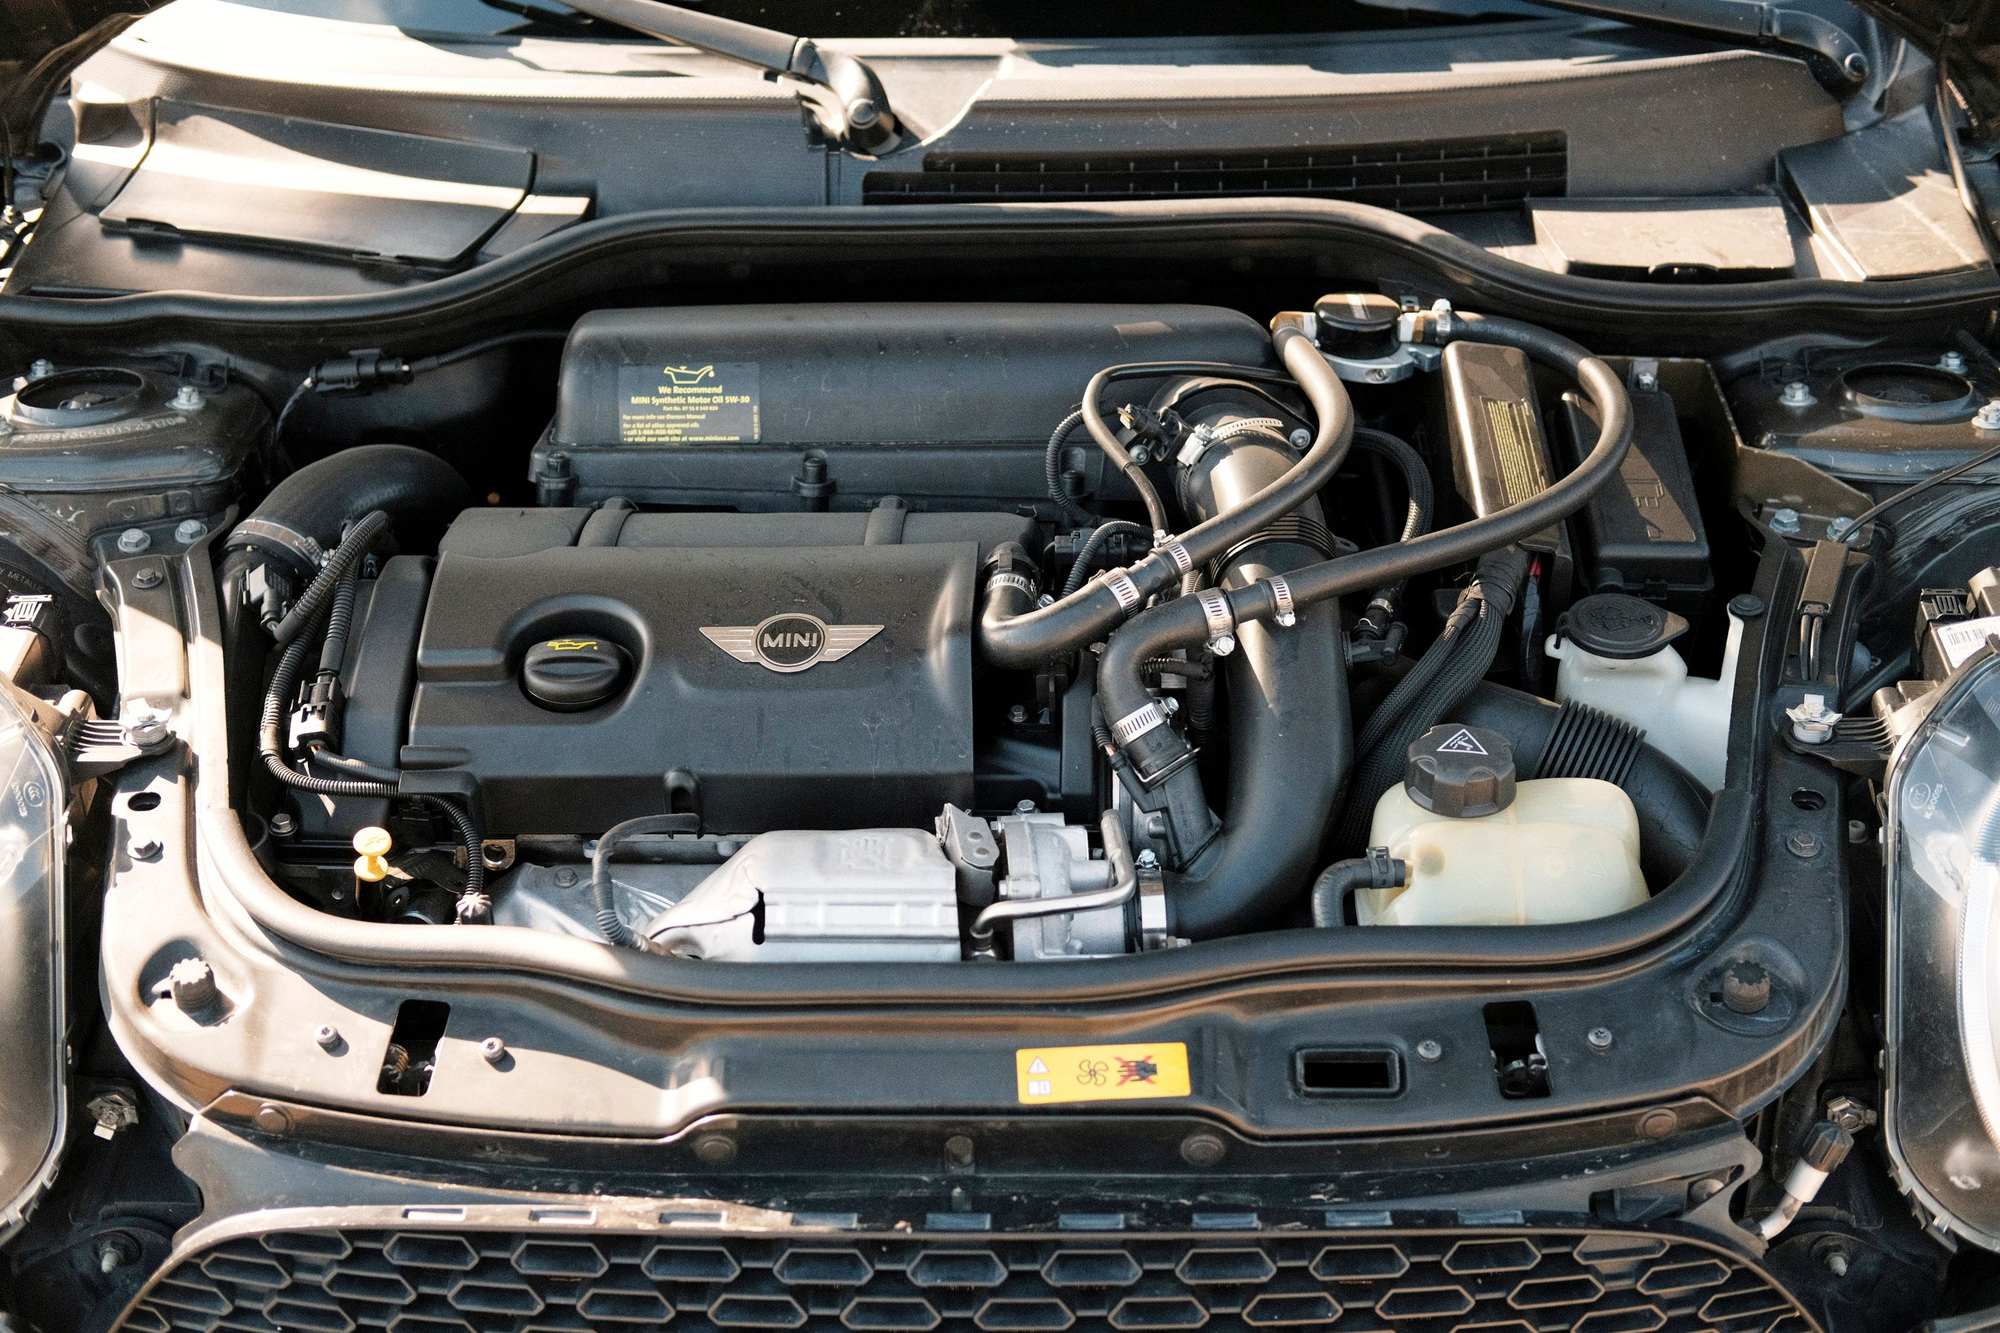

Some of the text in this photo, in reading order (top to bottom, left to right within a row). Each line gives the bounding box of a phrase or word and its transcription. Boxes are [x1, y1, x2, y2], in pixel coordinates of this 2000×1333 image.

[658, 385, 722, 394] We Recommend
[631, 395, 750, 406] MINI Synthetic Motor Oil 5W-30
[763, 632, 818, 648] MINI
